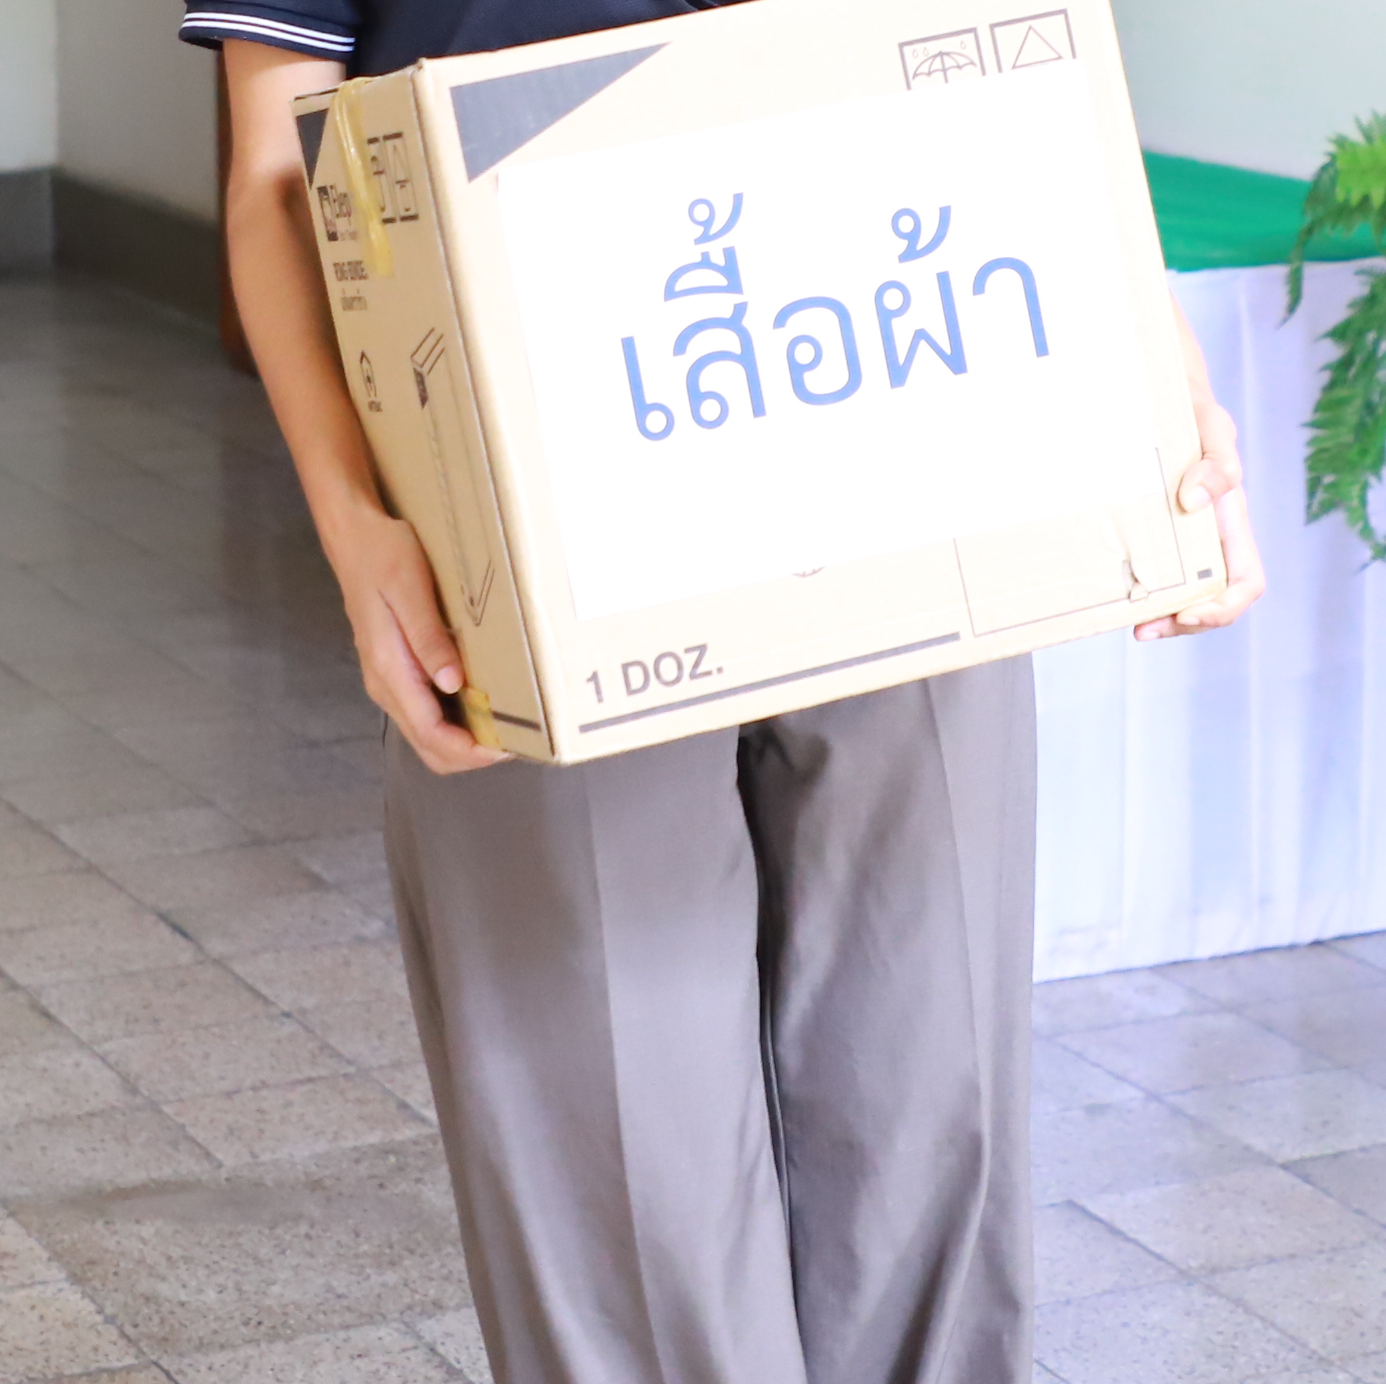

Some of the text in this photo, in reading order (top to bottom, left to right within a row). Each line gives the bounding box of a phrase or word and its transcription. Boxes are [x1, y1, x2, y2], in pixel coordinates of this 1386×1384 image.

[620, 191, 1050, 441] เสื้อผ้า
[585, 642, 725, 704] 1 DOZ.
